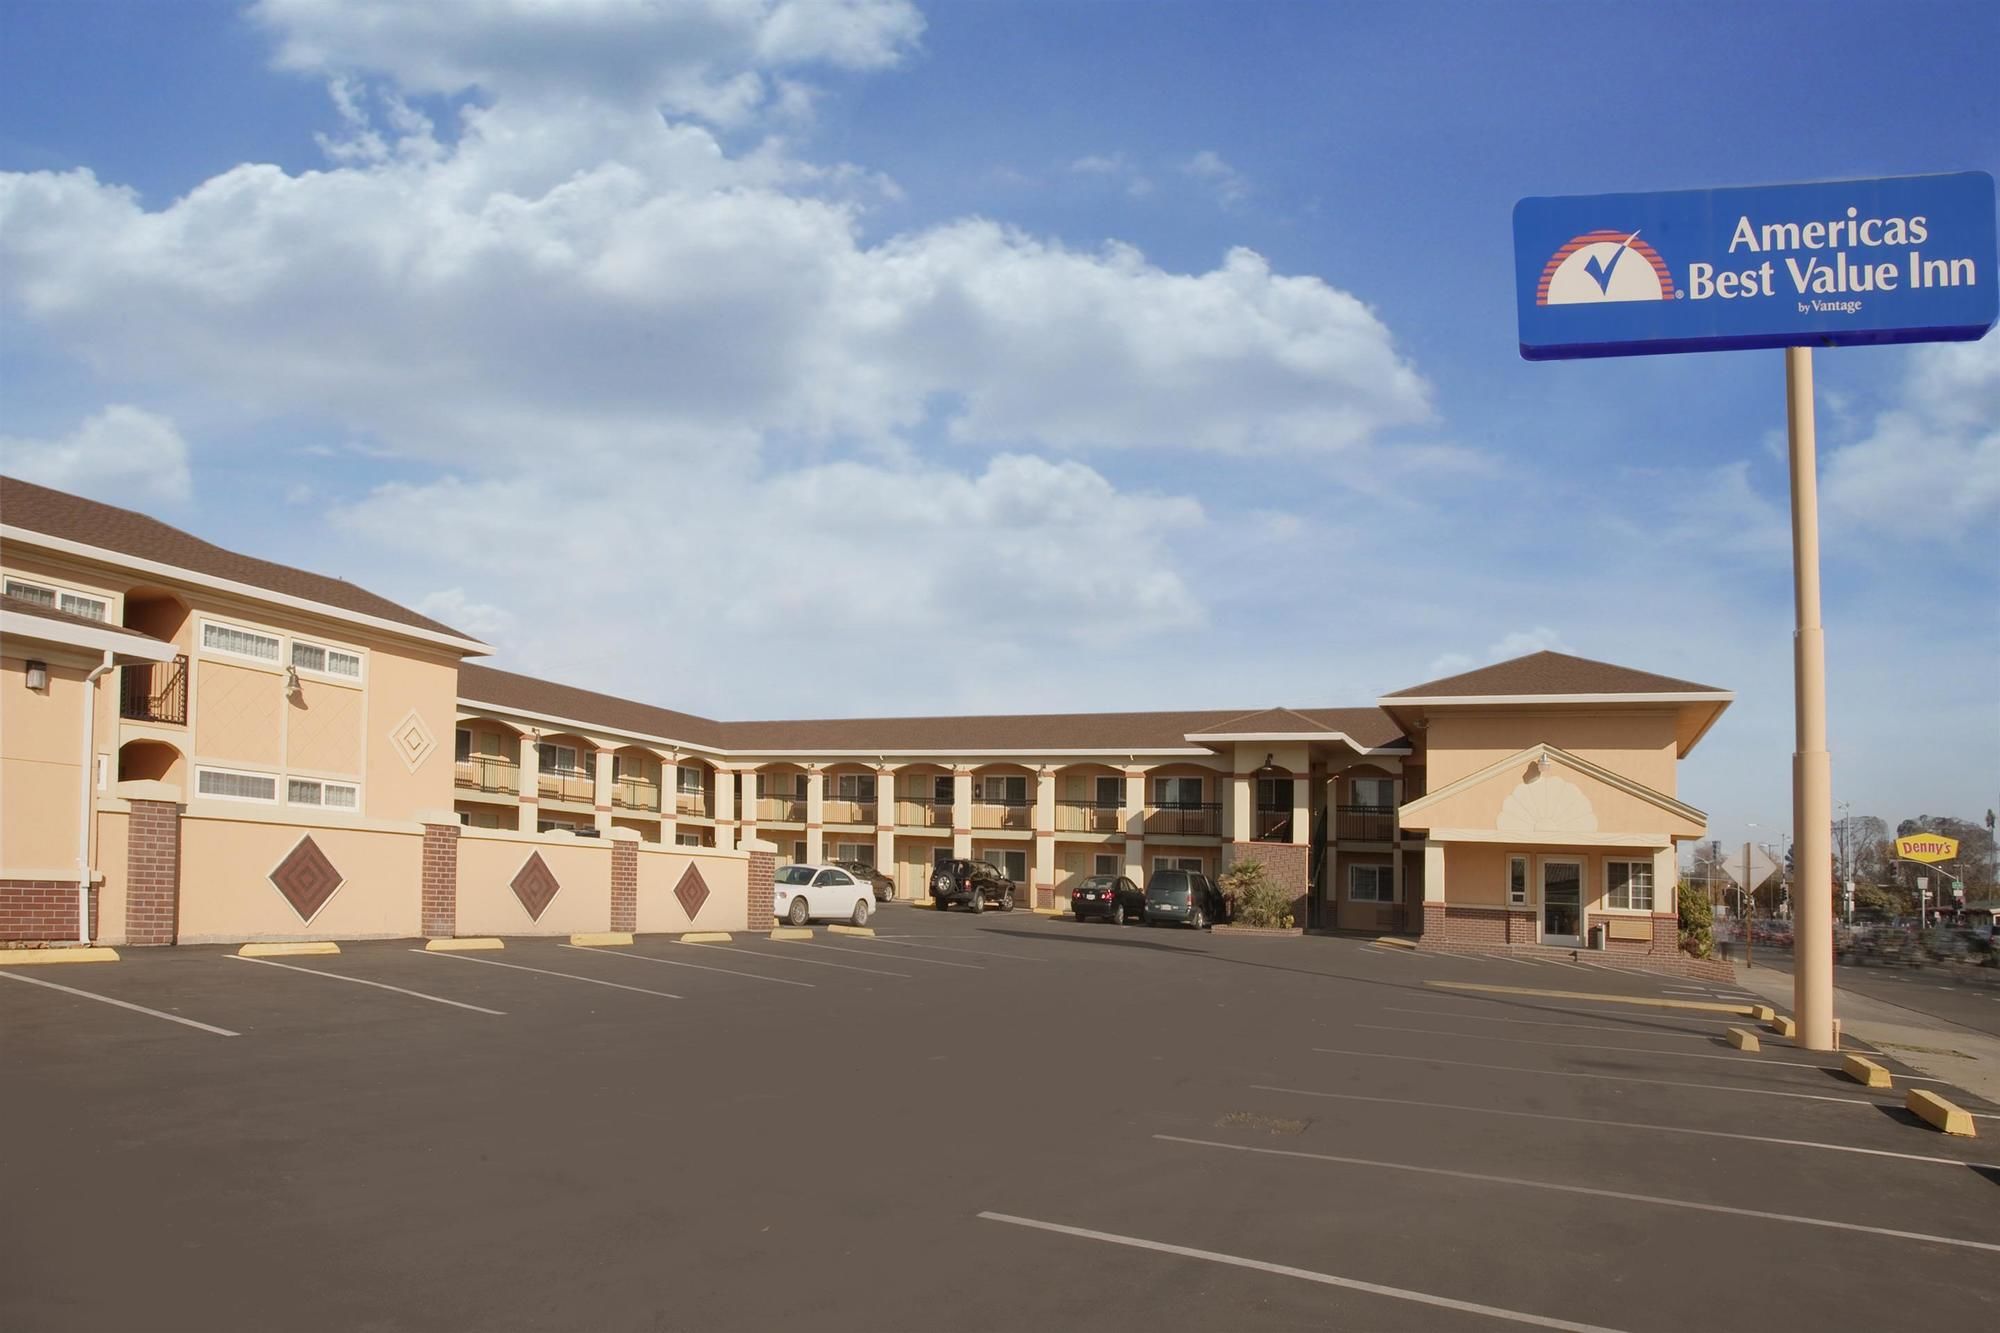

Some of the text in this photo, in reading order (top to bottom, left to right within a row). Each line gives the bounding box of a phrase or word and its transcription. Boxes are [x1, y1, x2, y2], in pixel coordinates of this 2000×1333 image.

[1728, 206, 1928, 254] Americas
[1689, 251, 1976, 300] Best Value Inn
[1798, 299, 1862, 314] by Vantage
[1902, 841, 1951, 856] Denny's
